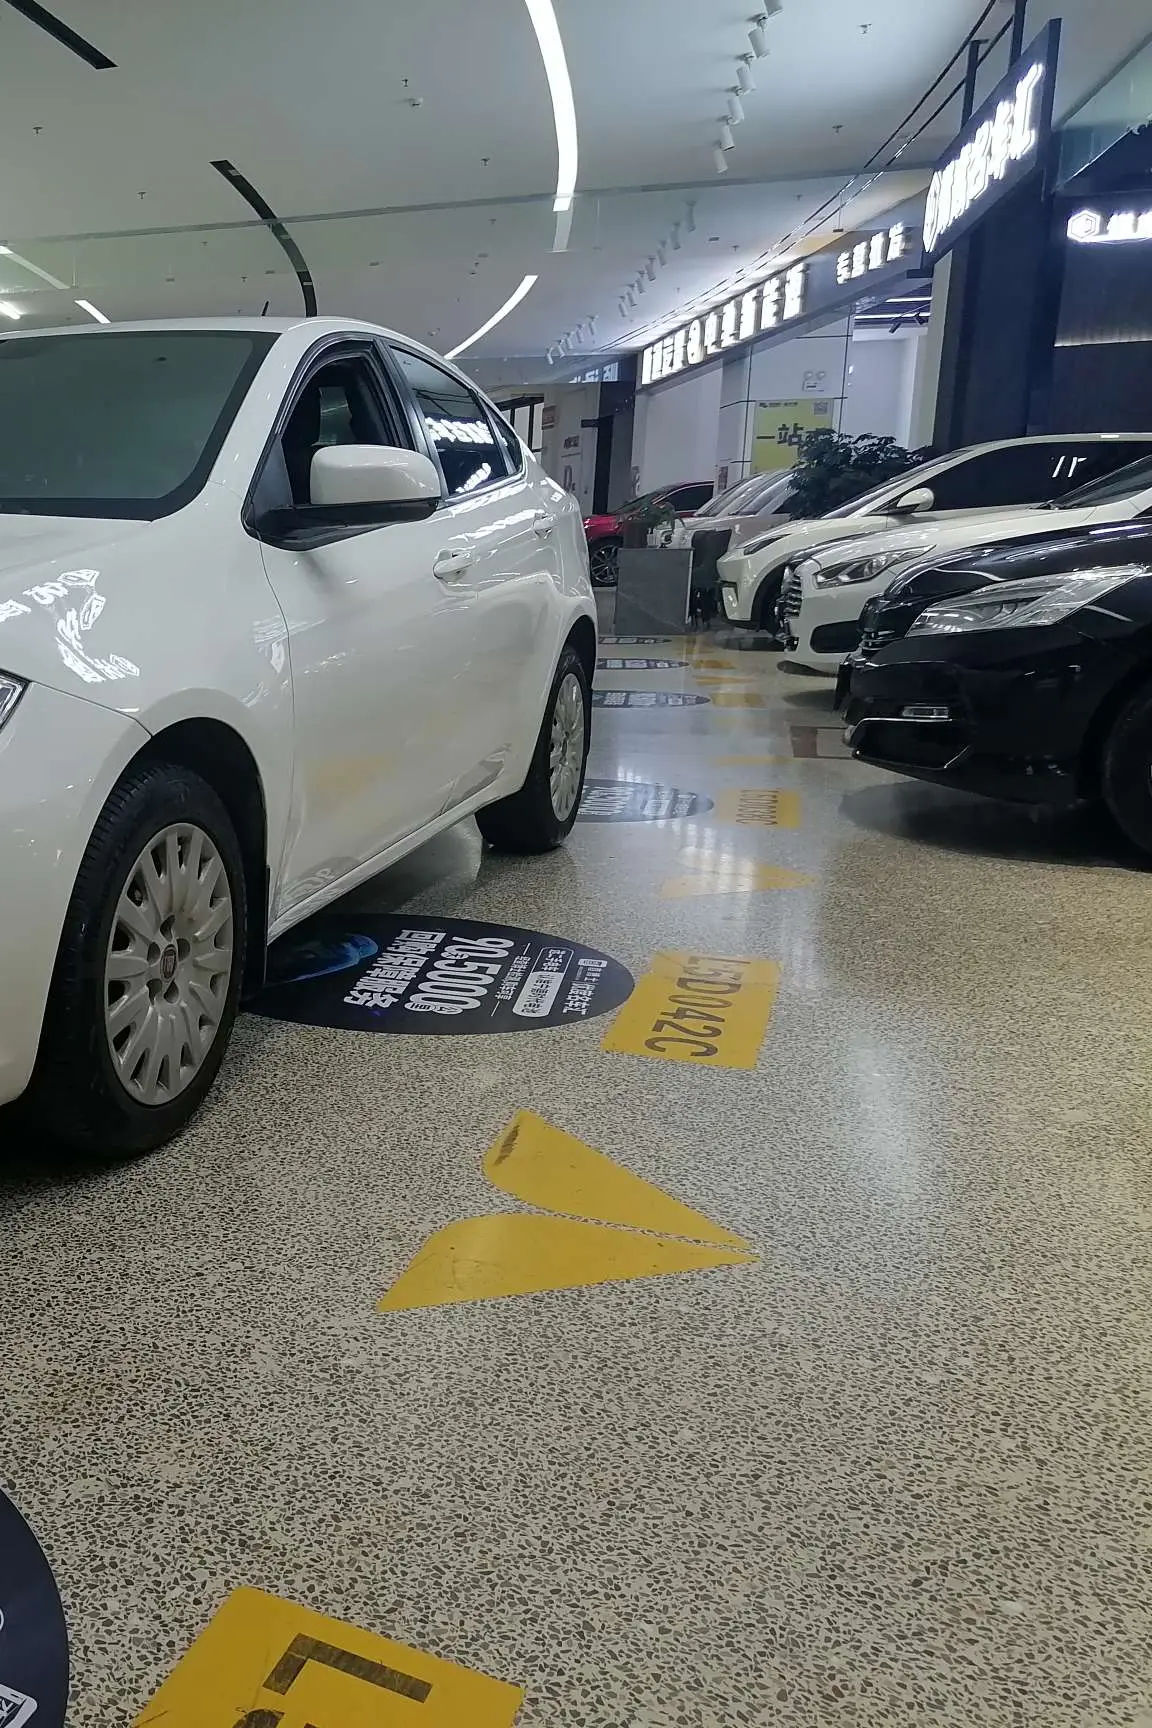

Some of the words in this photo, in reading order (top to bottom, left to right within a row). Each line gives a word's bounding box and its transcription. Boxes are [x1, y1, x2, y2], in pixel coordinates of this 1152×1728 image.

[343, 929, 447, 1009] 回购保障服务
